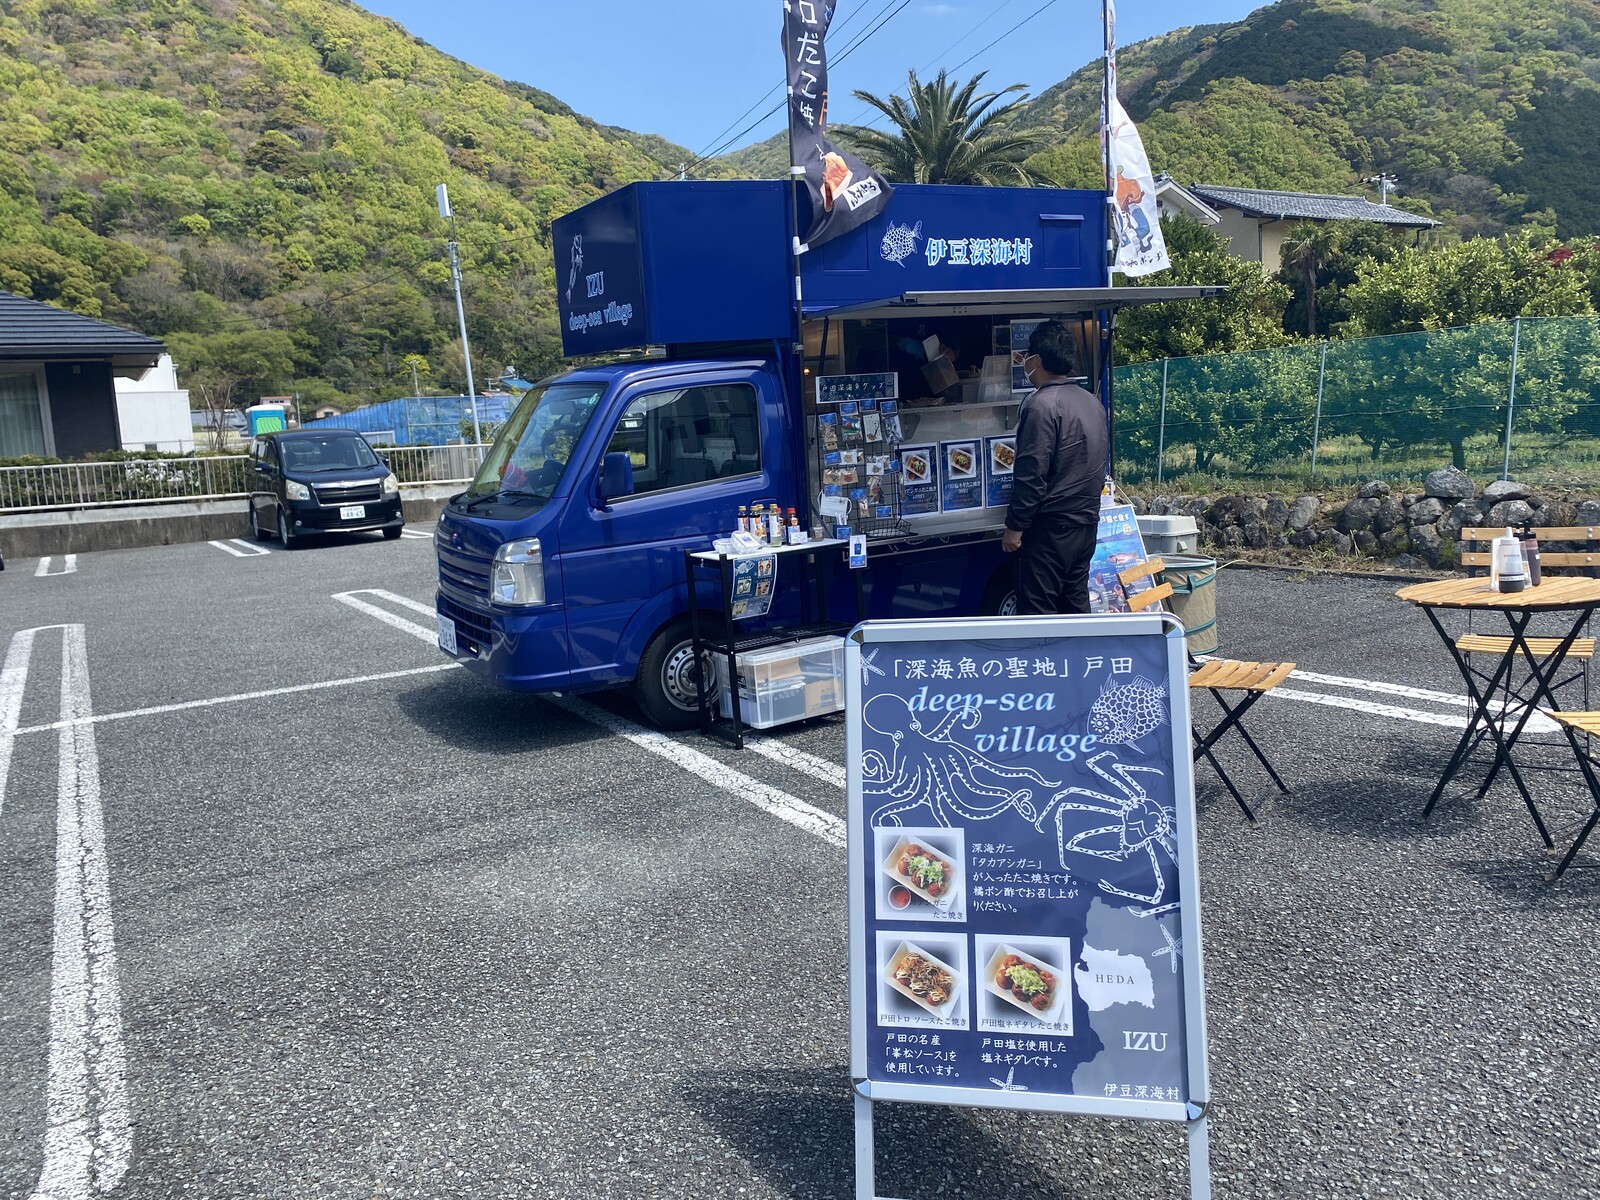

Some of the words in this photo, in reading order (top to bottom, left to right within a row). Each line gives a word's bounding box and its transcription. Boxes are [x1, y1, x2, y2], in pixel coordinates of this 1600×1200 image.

[925, 238, 1033, 266] 伊豆深海村
[586, 271, 604, 297] IZU
[569, 311, 603, 333] deep-sea
[603, 301, 632, 326] village
[907, 686, 1056, 720] deep-sea
[974, 726, 1098, 762] village
[971, 843, 1015, 854] 深海ガニ
[972, 857, 1042, 869] 「タカアシガニ」
[972, 872, 1078, 886] が入ったたこ焼きです。
[973, 900, 1017, 913] りください。
[933, 911, 963, 920] たこ焼き
[1096, 974, 1135, 985] HEDA
[885, 1032, 941, 1046] 戸田の名産
[981, 1037, 1067, 1053] 戸田塩を使用した
[1122, 1030, 1168, 1052] IZU
[980, 1052, 1058, 1068] 塩ネギダレです。
[885, 1061, 960, 1078] 使用しています。
[1103, 1082, 1180, 1101] 伊豆深海村
